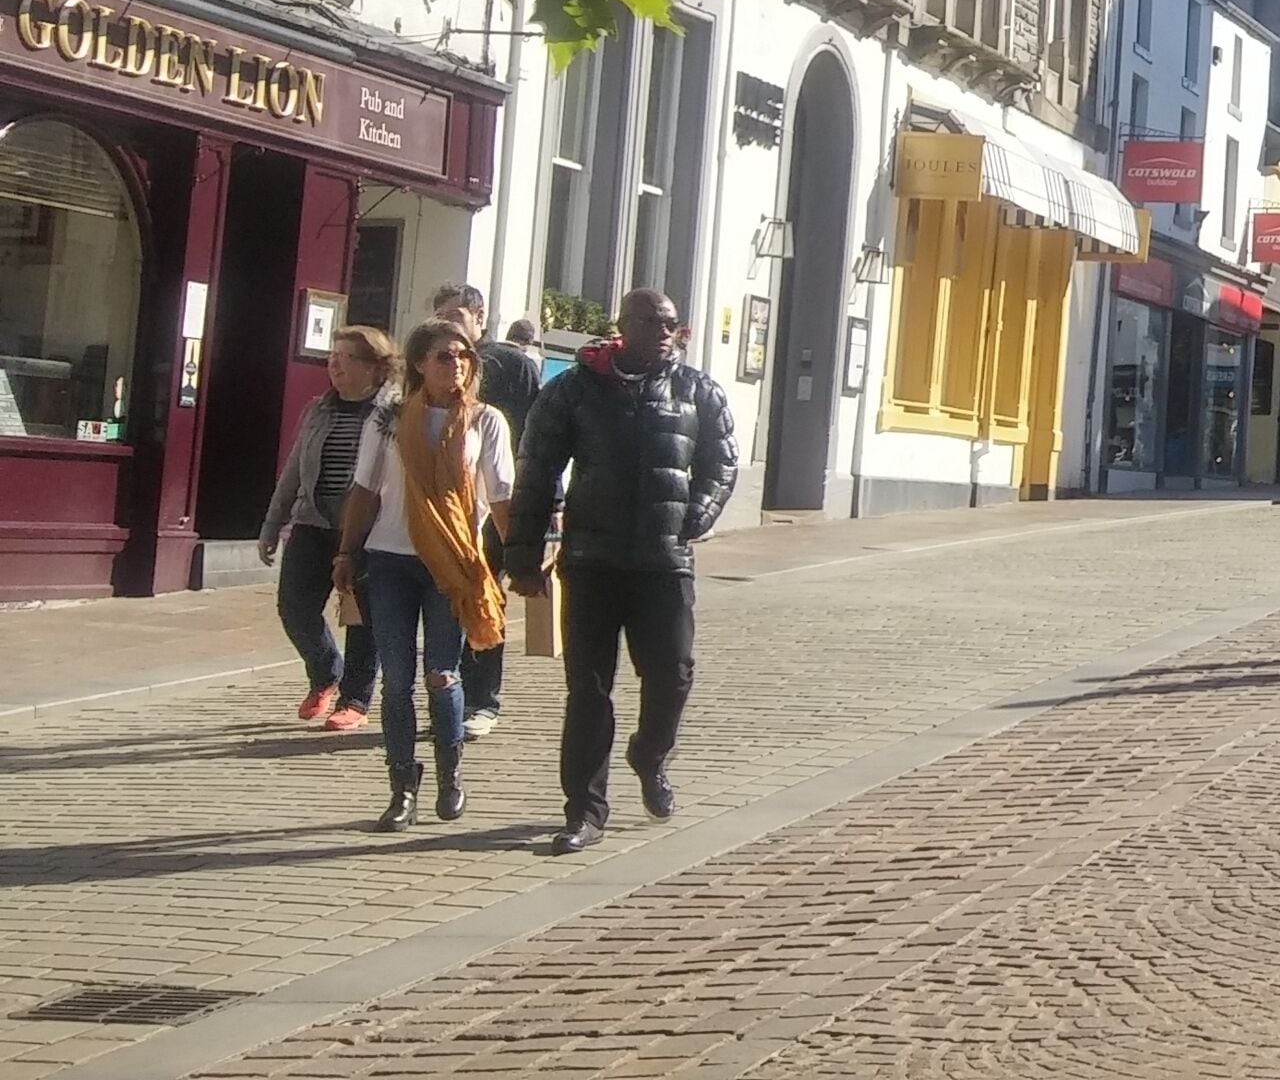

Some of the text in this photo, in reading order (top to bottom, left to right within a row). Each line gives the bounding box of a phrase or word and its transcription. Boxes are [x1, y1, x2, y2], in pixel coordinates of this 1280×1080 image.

[221, 44, 326, 128] LION
[360, 86, 405, 119] Pub and
[359, 117, 401, 149] Kitchen
[904, 159, 978, 173] JOULES
[1127, 167, 1197, 179] COTSWOLD
[1146, 178, 1178, 187] outdoor
